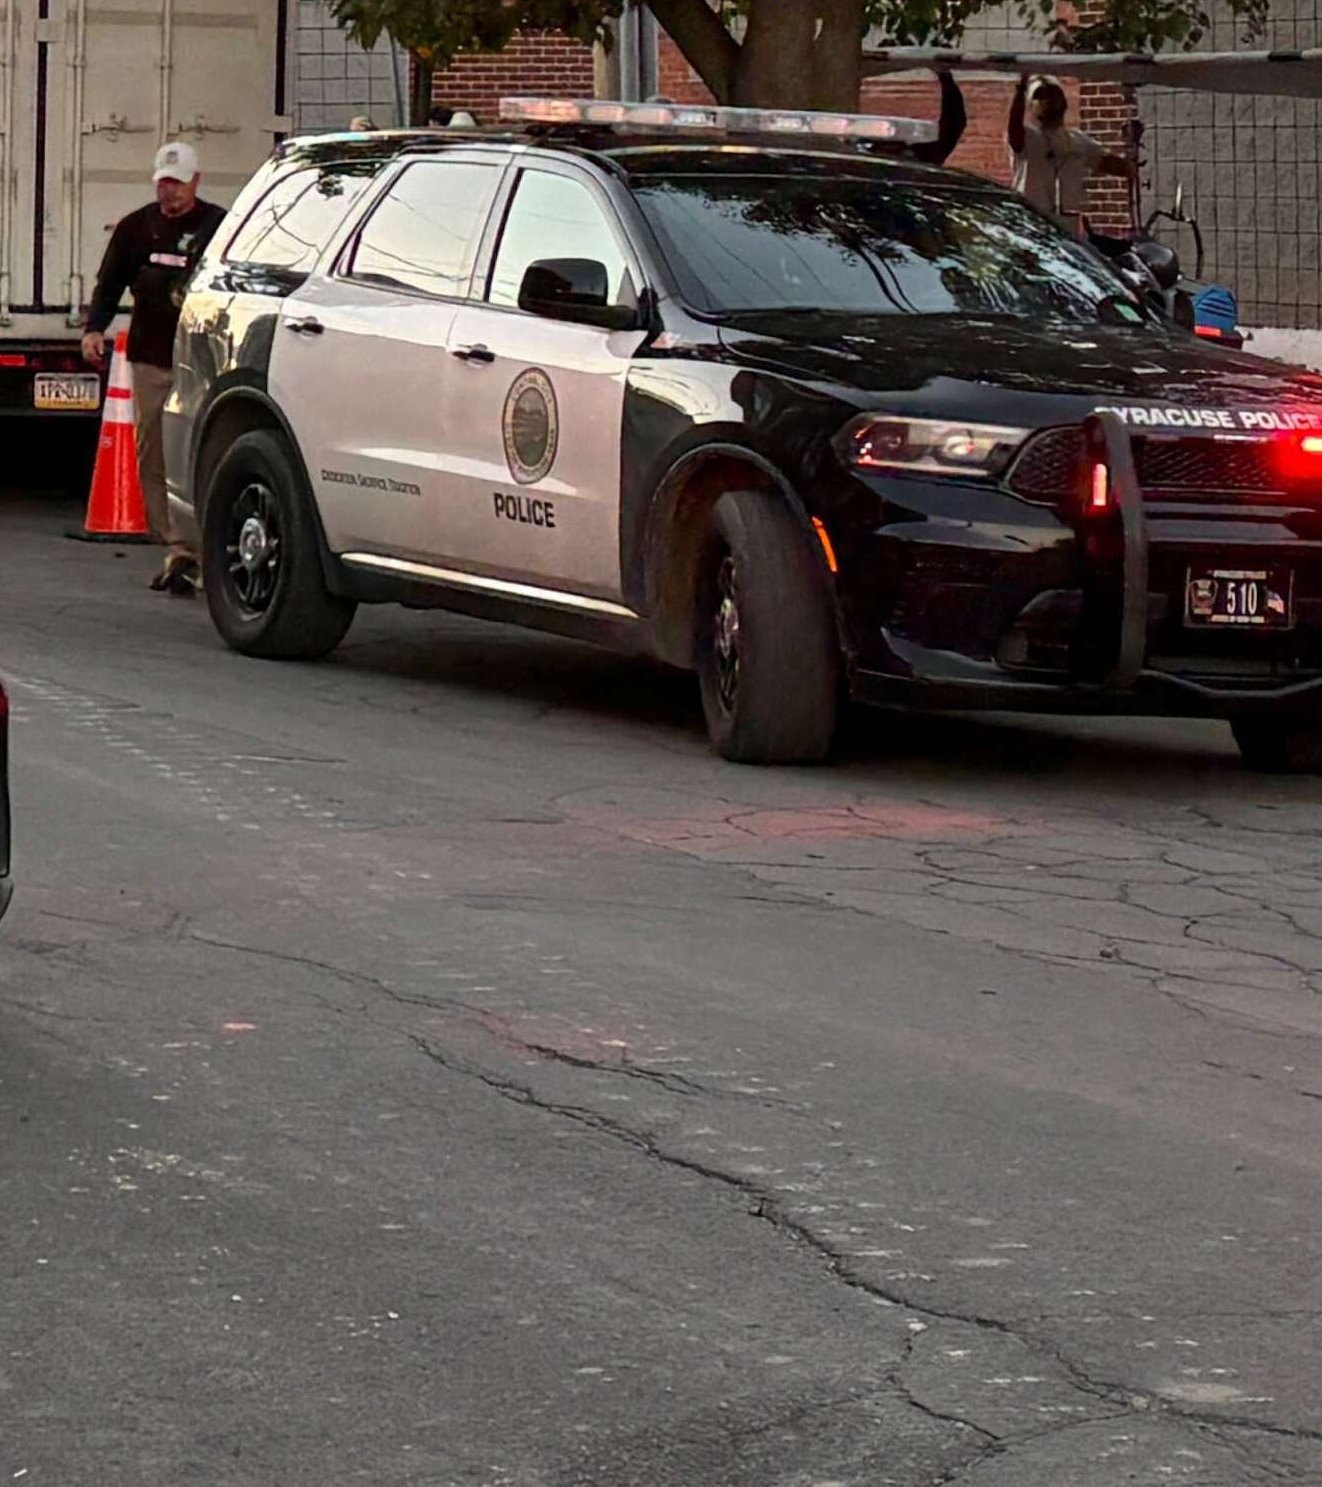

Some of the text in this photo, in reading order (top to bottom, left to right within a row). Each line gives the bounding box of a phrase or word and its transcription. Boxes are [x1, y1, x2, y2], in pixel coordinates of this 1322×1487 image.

[1238, 411, 1322, 430] POLICE
[493, 493, 556, 528] POLICE
[1226, 581, 1258, 614] 510
